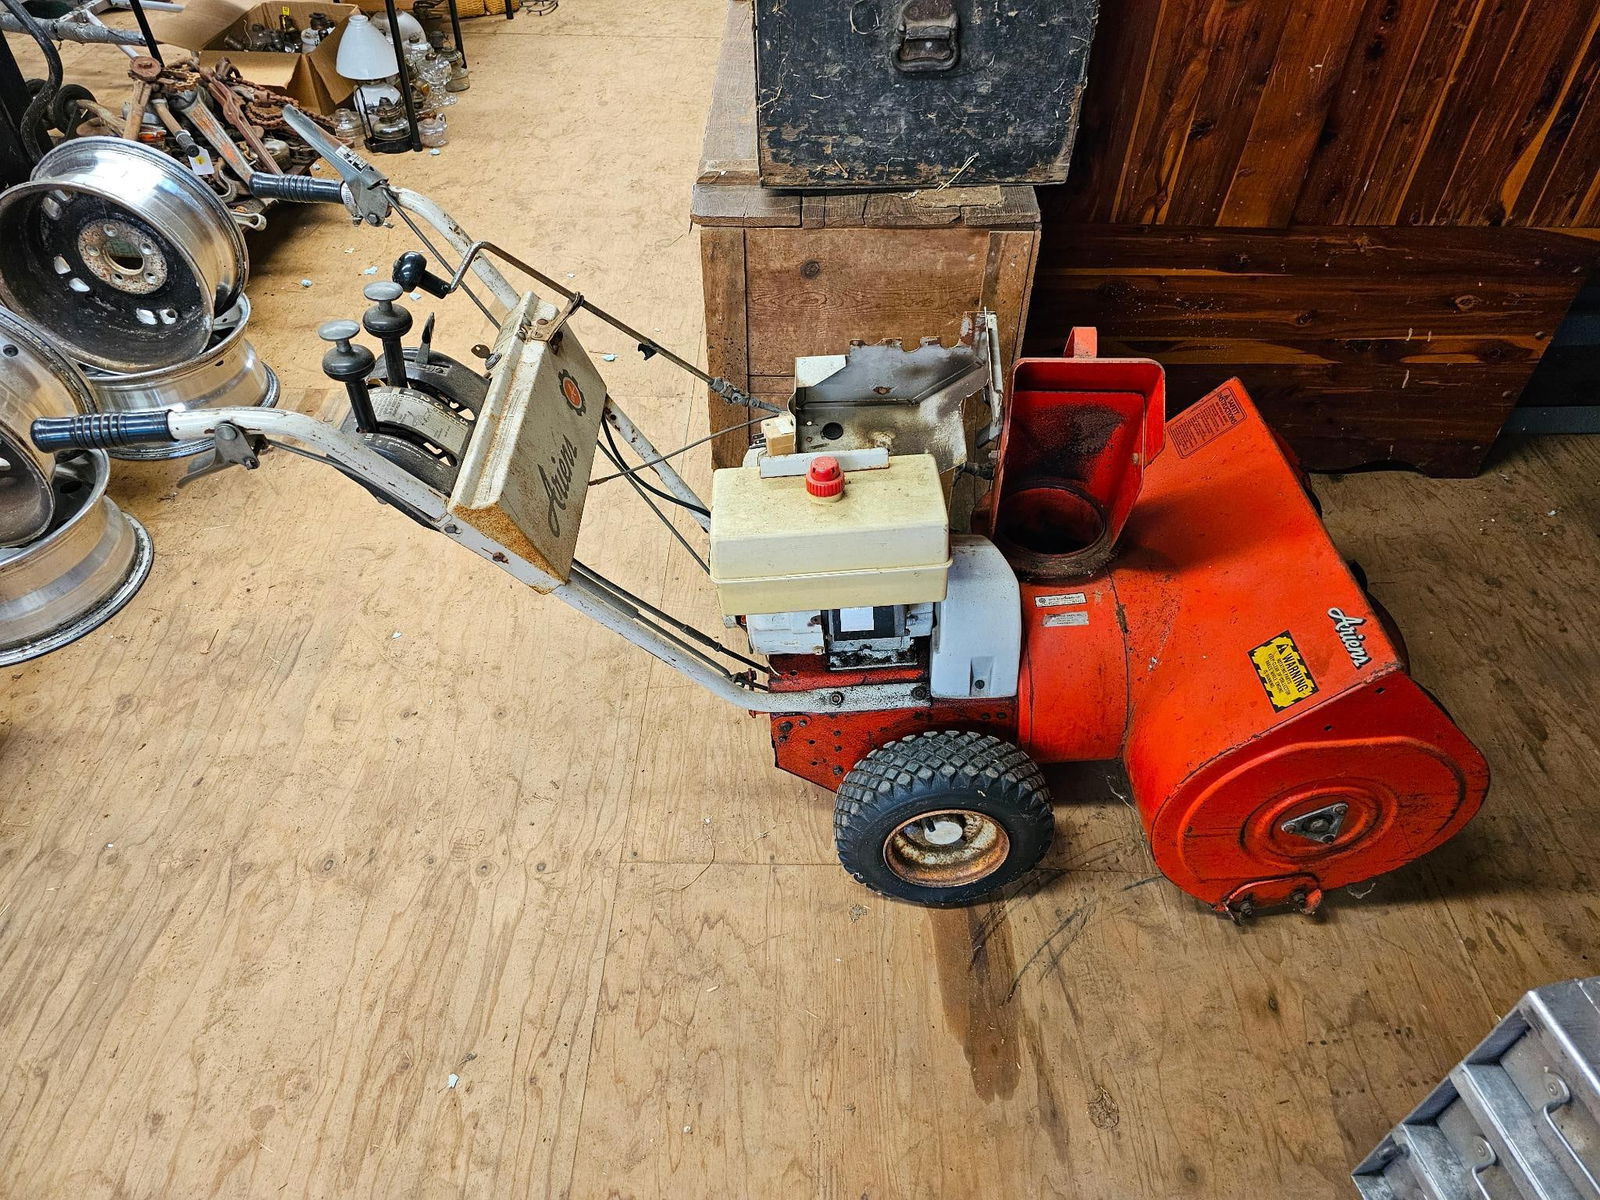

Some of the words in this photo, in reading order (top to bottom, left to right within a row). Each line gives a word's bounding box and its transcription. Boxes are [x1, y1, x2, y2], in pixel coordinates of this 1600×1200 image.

[537, 433, 578, 538] Ariens
[1327, 607, 1372, 670] Ariens
[1281, 653, 1309, 693] WARNING
